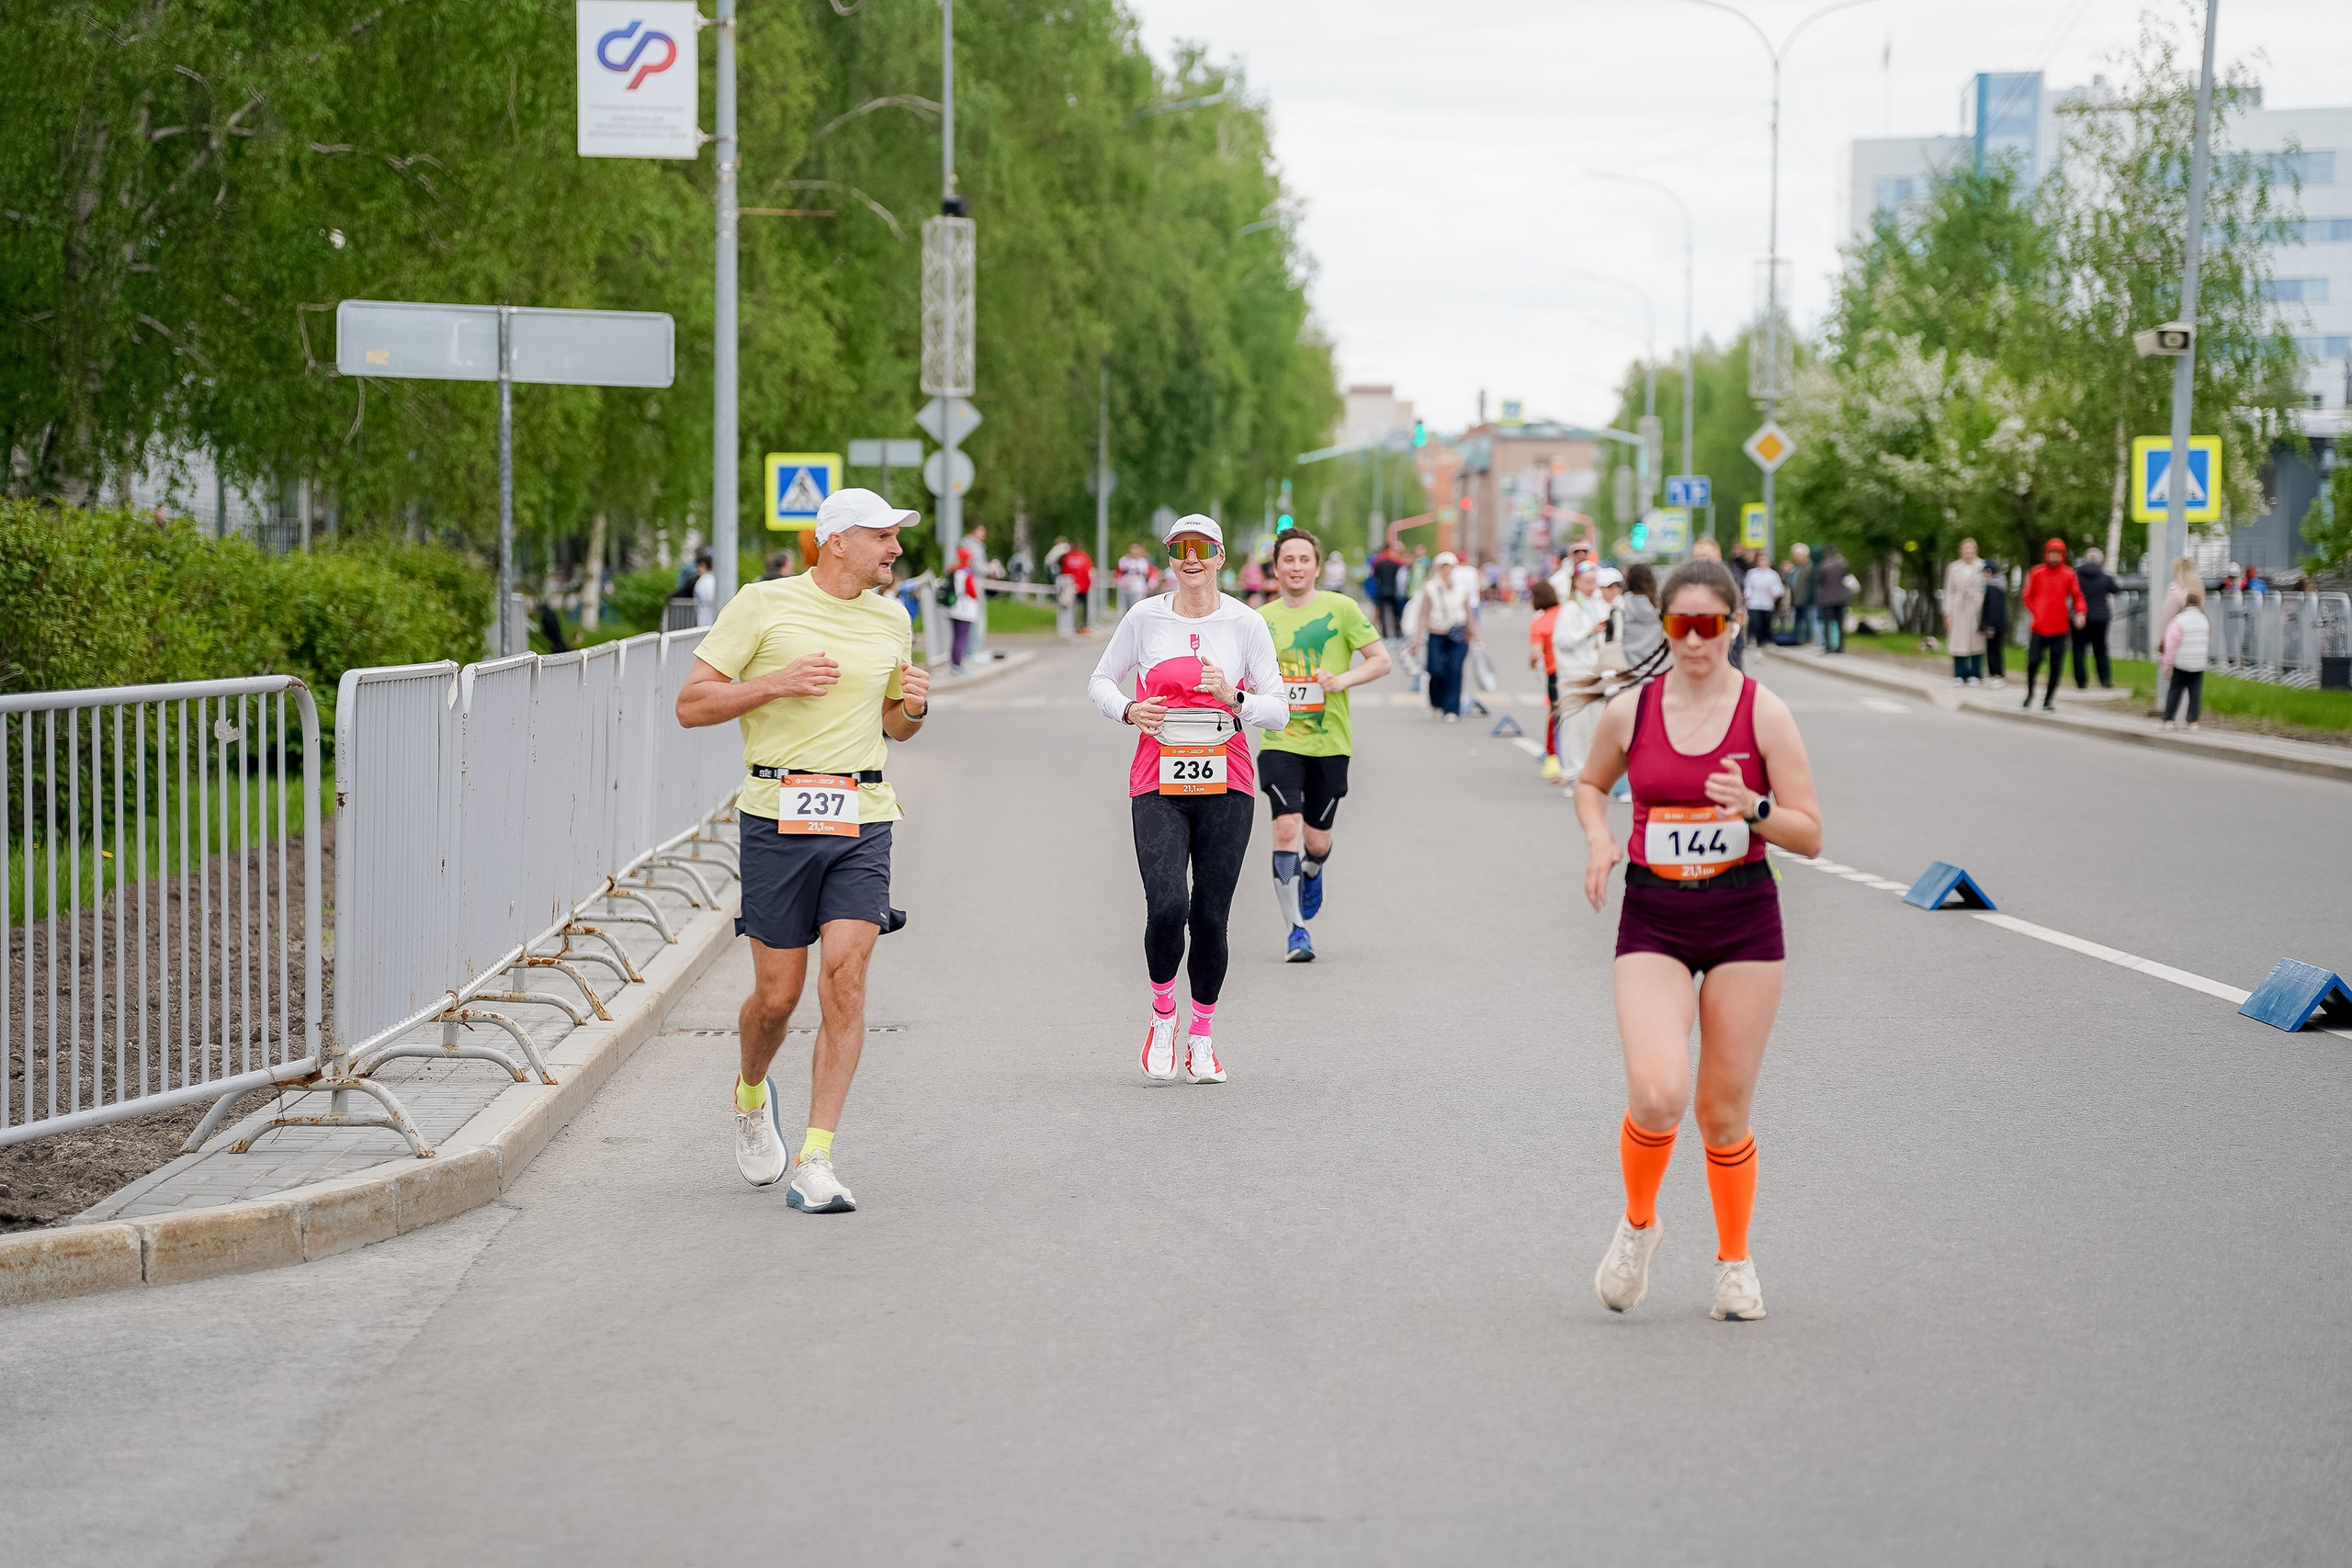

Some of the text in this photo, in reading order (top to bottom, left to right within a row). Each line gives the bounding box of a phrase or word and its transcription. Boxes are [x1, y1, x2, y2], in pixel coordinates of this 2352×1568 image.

[1289, 686, 1307, 700] 67
[1173, 761, 1214, 779] 236
[797, 792, 845, 816] 237
[1668, 829, 1728, 856] 144
